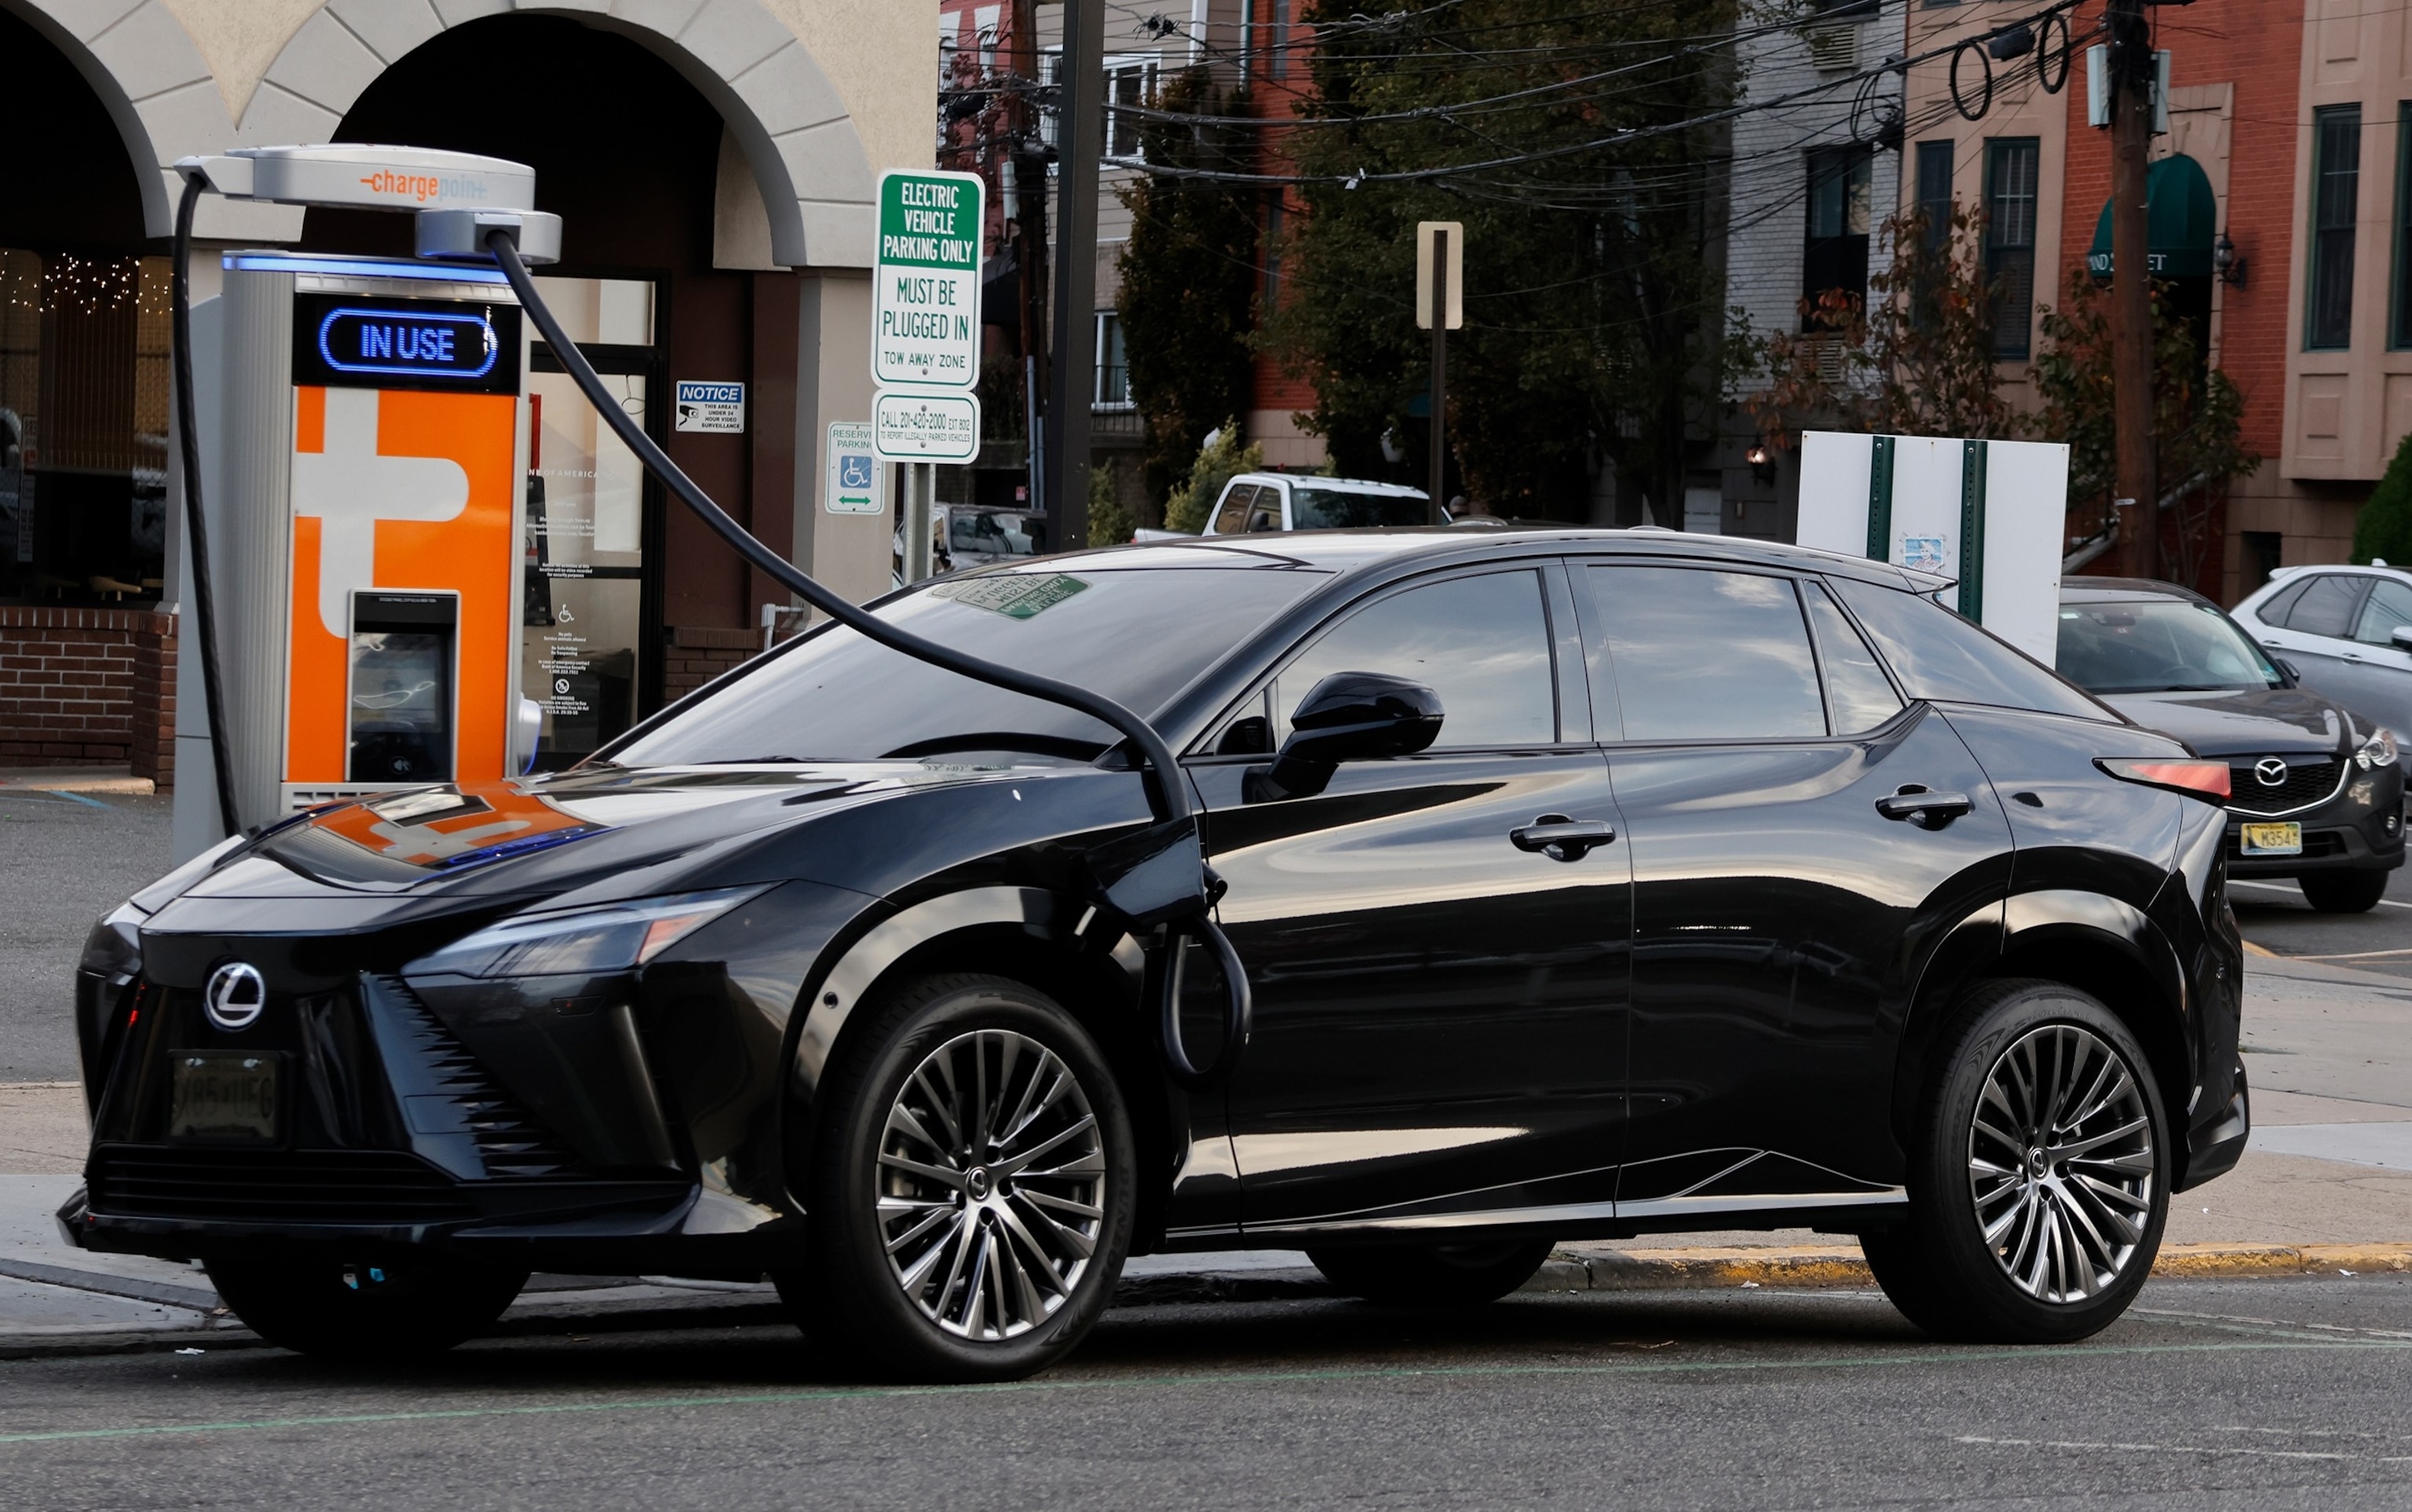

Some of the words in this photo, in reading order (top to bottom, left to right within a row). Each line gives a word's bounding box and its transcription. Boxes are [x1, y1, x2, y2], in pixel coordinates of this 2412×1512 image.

[901, 182, 959, 209] ELECTRIC
[904, 209, 956, 235] VEHICLE
[883, 235, 938, 261] PARKING
[941, 239, 974, 263] ONLY
[897, 277, 934, 305] MUST
[938, 279, 956, 305] BE
[883, 310, 948, 339] PLUGGED
[955, 315, 968, 341] IN
[361, 325, 391, 358] IN
[398, 327, 455, 361] USE
[884, 351, 904, 364] TOW
[908, 352, 935, 367] AWAY
[939, 355, 966, 368] ZONE
[682, 386, 739, 401] NOTICE
[881, 411, 897, 428] CALL
[901, 411, 946, 429] 201-420-2000
[948, 418, 958, 431] EXT
[887, 431, 904, 440] REPORT
[904, 432, 927, 440] ILLEGALLY
[929, 433, 947, 441] PARKED
[948, 433, 970, 442] VEHICLES
